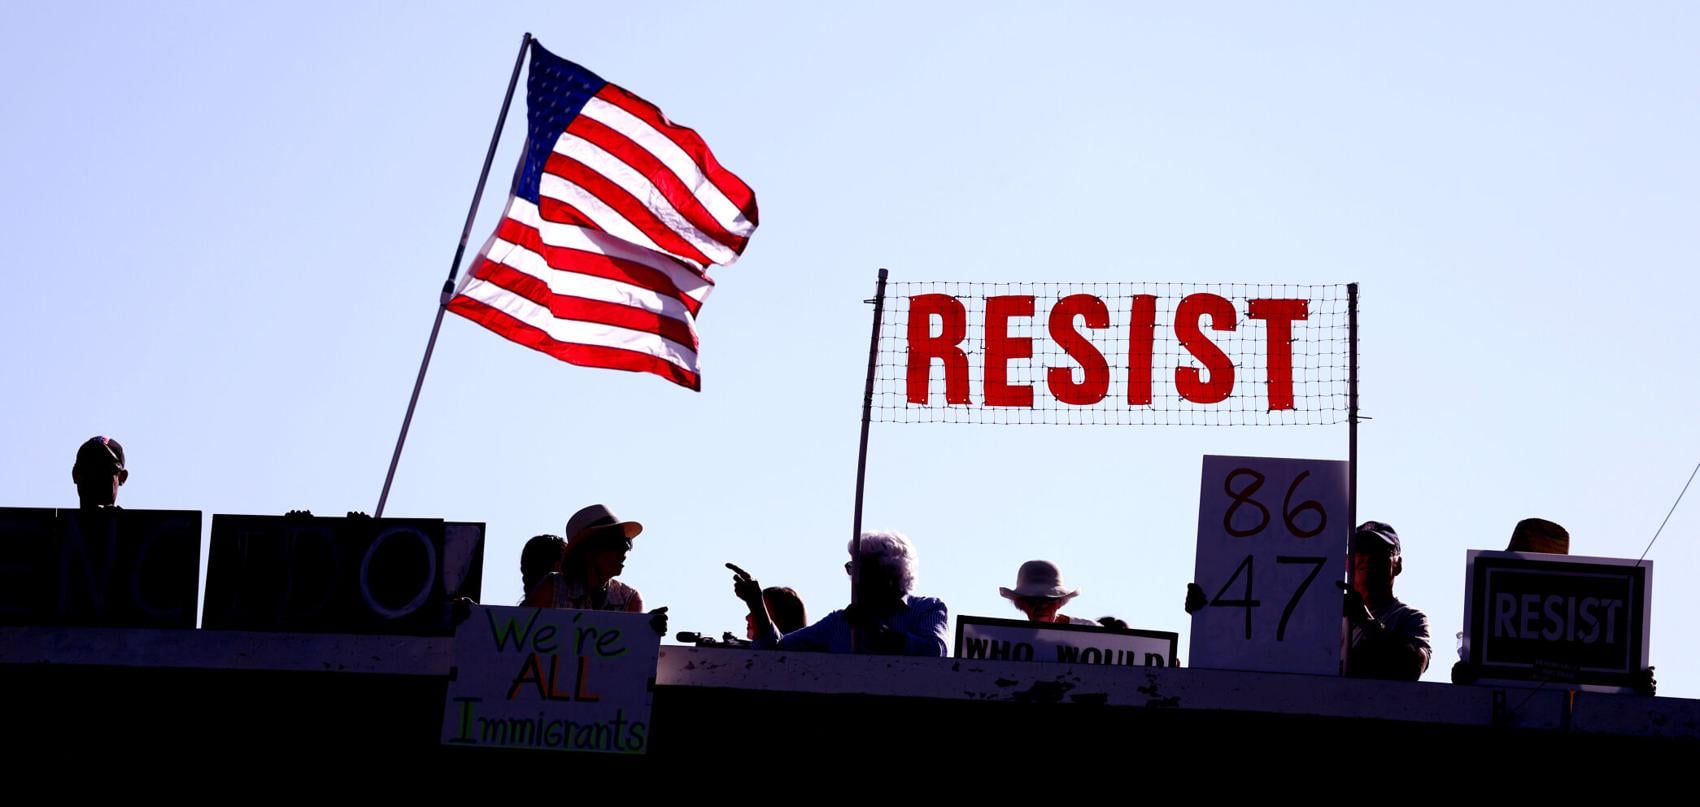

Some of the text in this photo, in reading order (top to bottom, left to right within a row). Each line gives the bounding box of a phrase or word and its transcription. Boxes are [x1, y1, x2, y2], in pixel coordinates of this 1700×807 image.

[907, 293, 1308, 410] RESIST
[1224, 468, 1327, 538] 86
[1210, 555, 1327, 641] 47
[1494, 592, 1623, 645] RESIST
[486, 608, 629, 656] We're
[966, 637, 1034, 661] WHO
[507, 653, 599, 702] ALL
